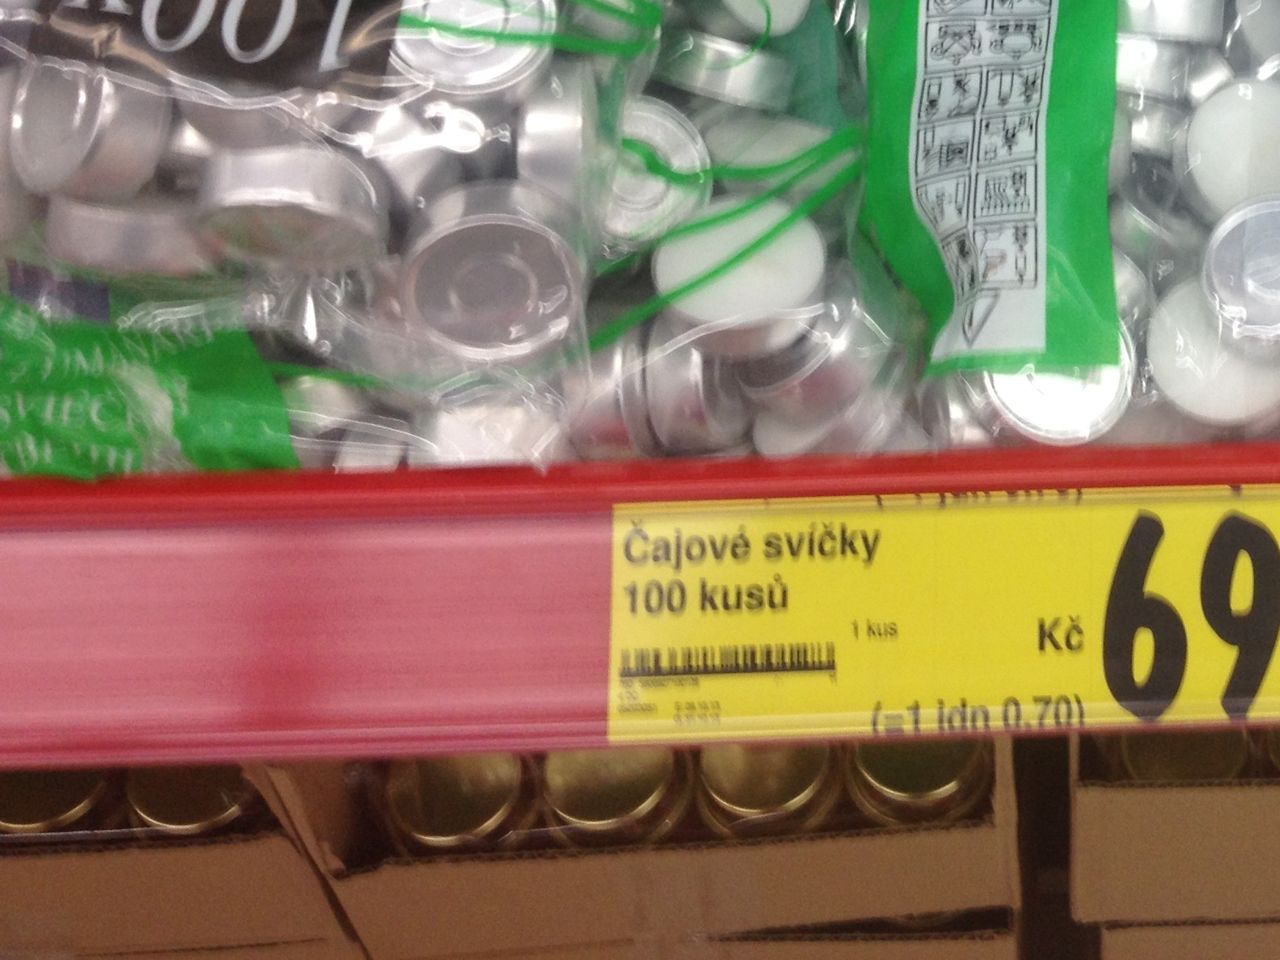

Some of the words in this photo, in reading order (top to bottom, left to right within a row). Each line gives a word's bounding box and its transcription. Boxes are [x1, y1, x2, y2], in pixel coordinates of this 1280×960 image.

[623, 518, 752, 572] Čajové
[762, 520, 881, 568] svíčky
[622, 577, 687, 615] 100
[699, 572, 789, 613] kusů
[866, 618, 899, 638] kus
[1036, 615, 1085, 653] Kč
